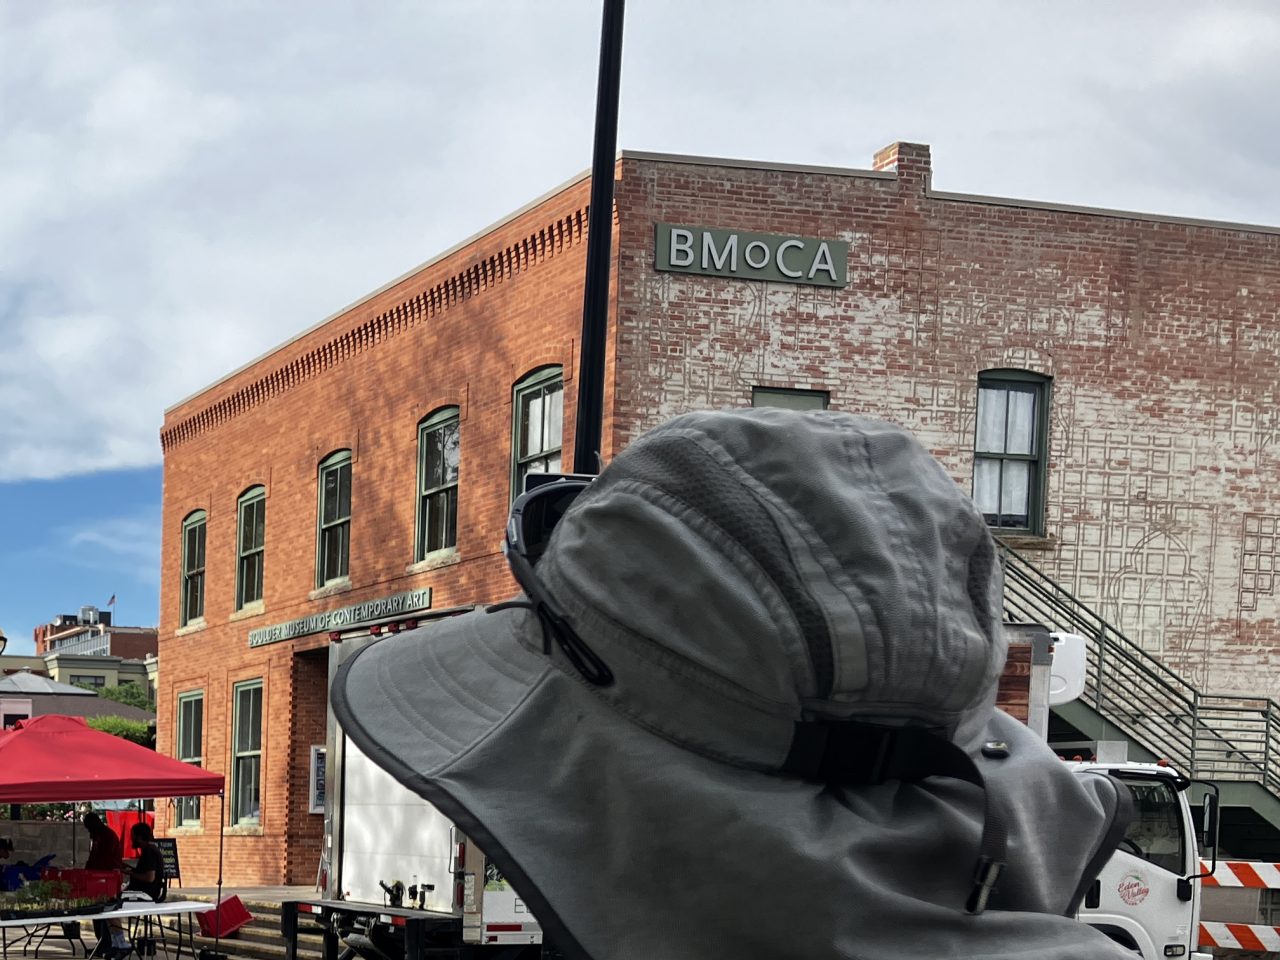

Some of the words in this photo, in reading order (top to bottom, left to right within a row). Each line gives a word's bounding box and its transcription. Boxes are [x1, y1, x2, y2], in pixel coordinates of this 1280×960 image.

[249, 628, 281, 645] BOULDER
[284, 618, 317, 637] MUSEUM
[320, 614, 331, 628] OF
[332, 596, 404, 625] CONTEMPORARY
[407, 591, 427, 609] ART
